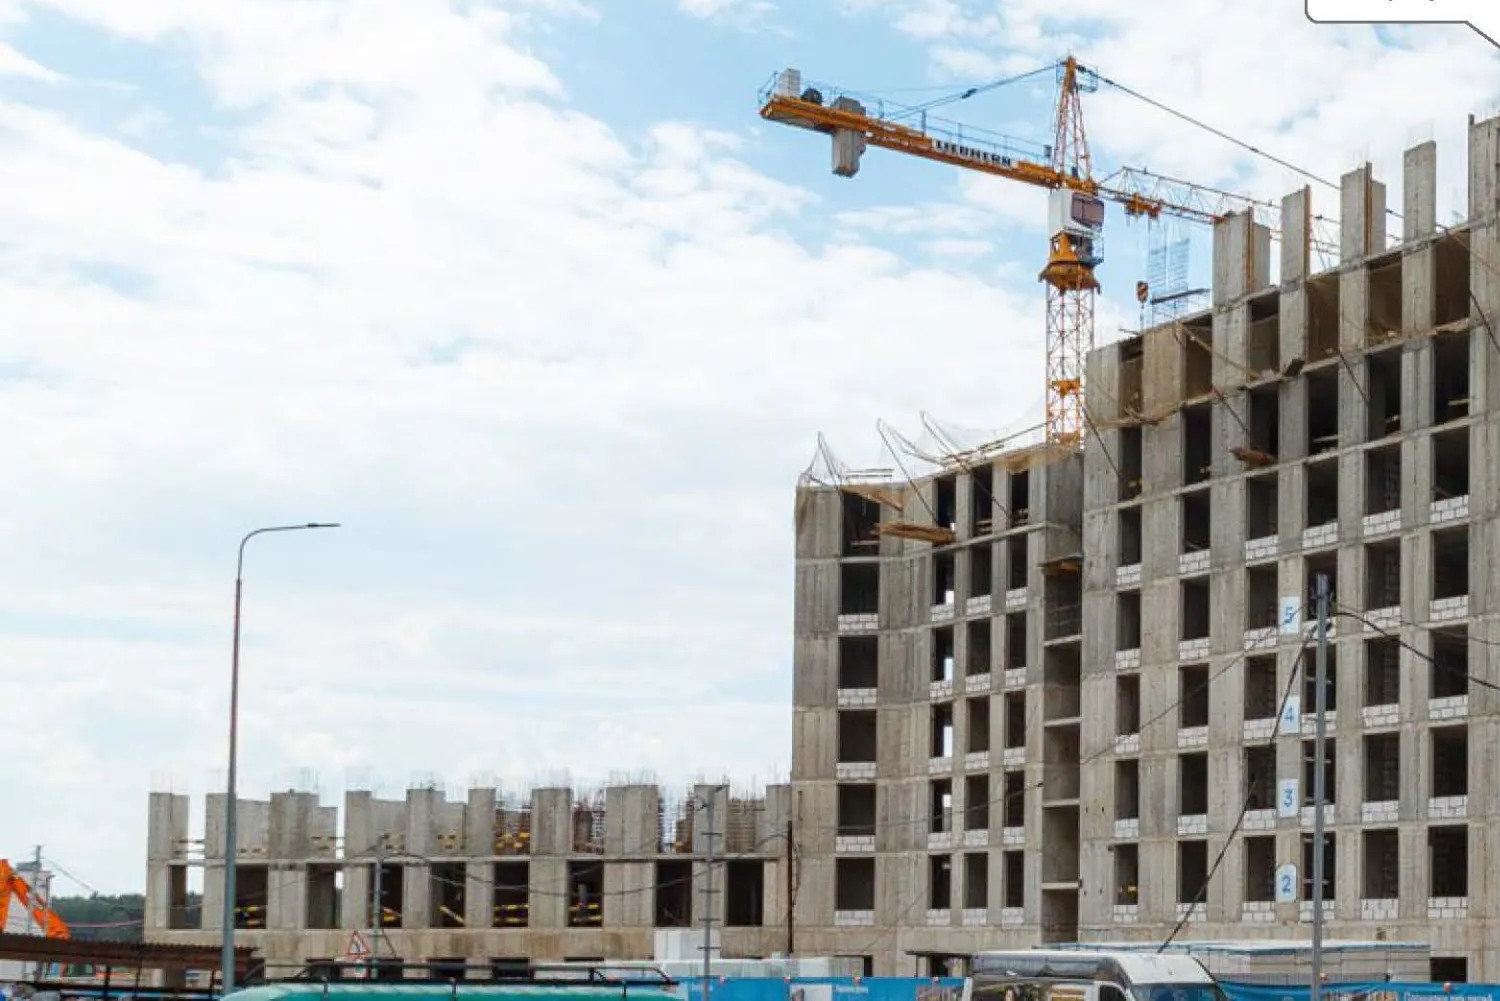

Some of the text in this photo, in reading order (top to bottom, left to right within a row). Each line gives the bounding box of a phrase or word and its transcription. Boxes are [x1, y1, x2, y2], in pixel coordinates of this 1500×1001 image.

[1284, 606, 1295, 625] 5
[1284, 706, 1295, 723] 4
[1283, 787, 1294, 808] 3
[1280, 874, 1292, 894] 2
